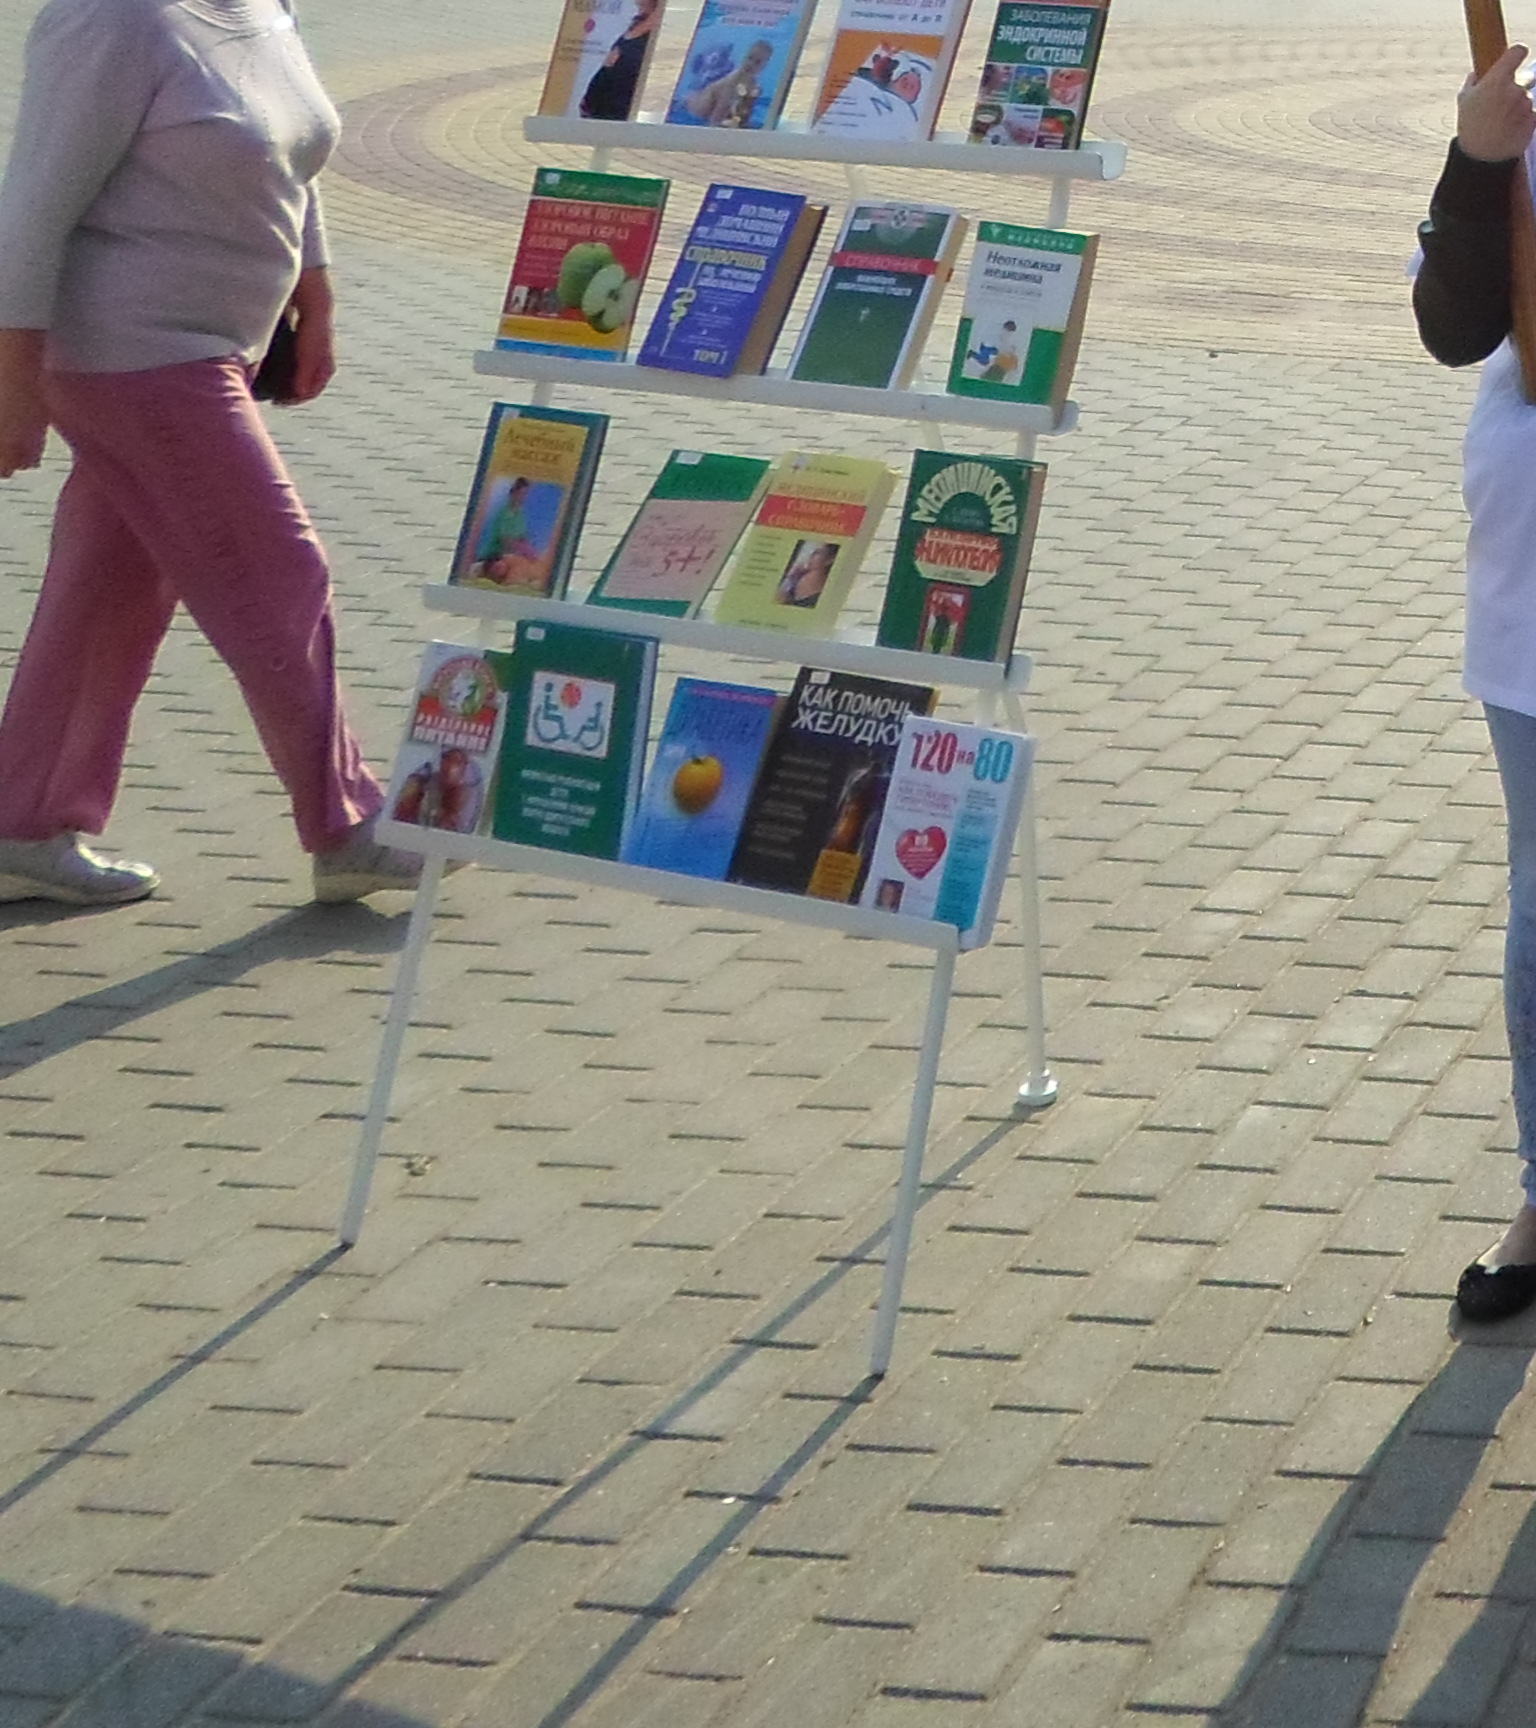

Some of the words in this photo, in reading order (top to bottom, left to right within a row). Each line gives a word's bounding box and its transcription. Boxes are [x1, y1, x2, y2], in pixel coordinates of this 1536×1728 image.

[1011, 8, 1093, 26] ЗАБОЛЕВАНИЯ
[997, 24, 1088, 47] ЭНДОКРИННОЙ
[1025, 45, 1085, 65] СИСТЕМЫ
[799, 684, 840, 711] КАК
[837, 690, 912, 722] ПОМОЧЬ
[790, 706, 903, 747] ЖЕЛУДКУ
[911, 728, 959, 775] 120
[955, 749, 976, 766] на
[973, 737, 1014, 784] 80
